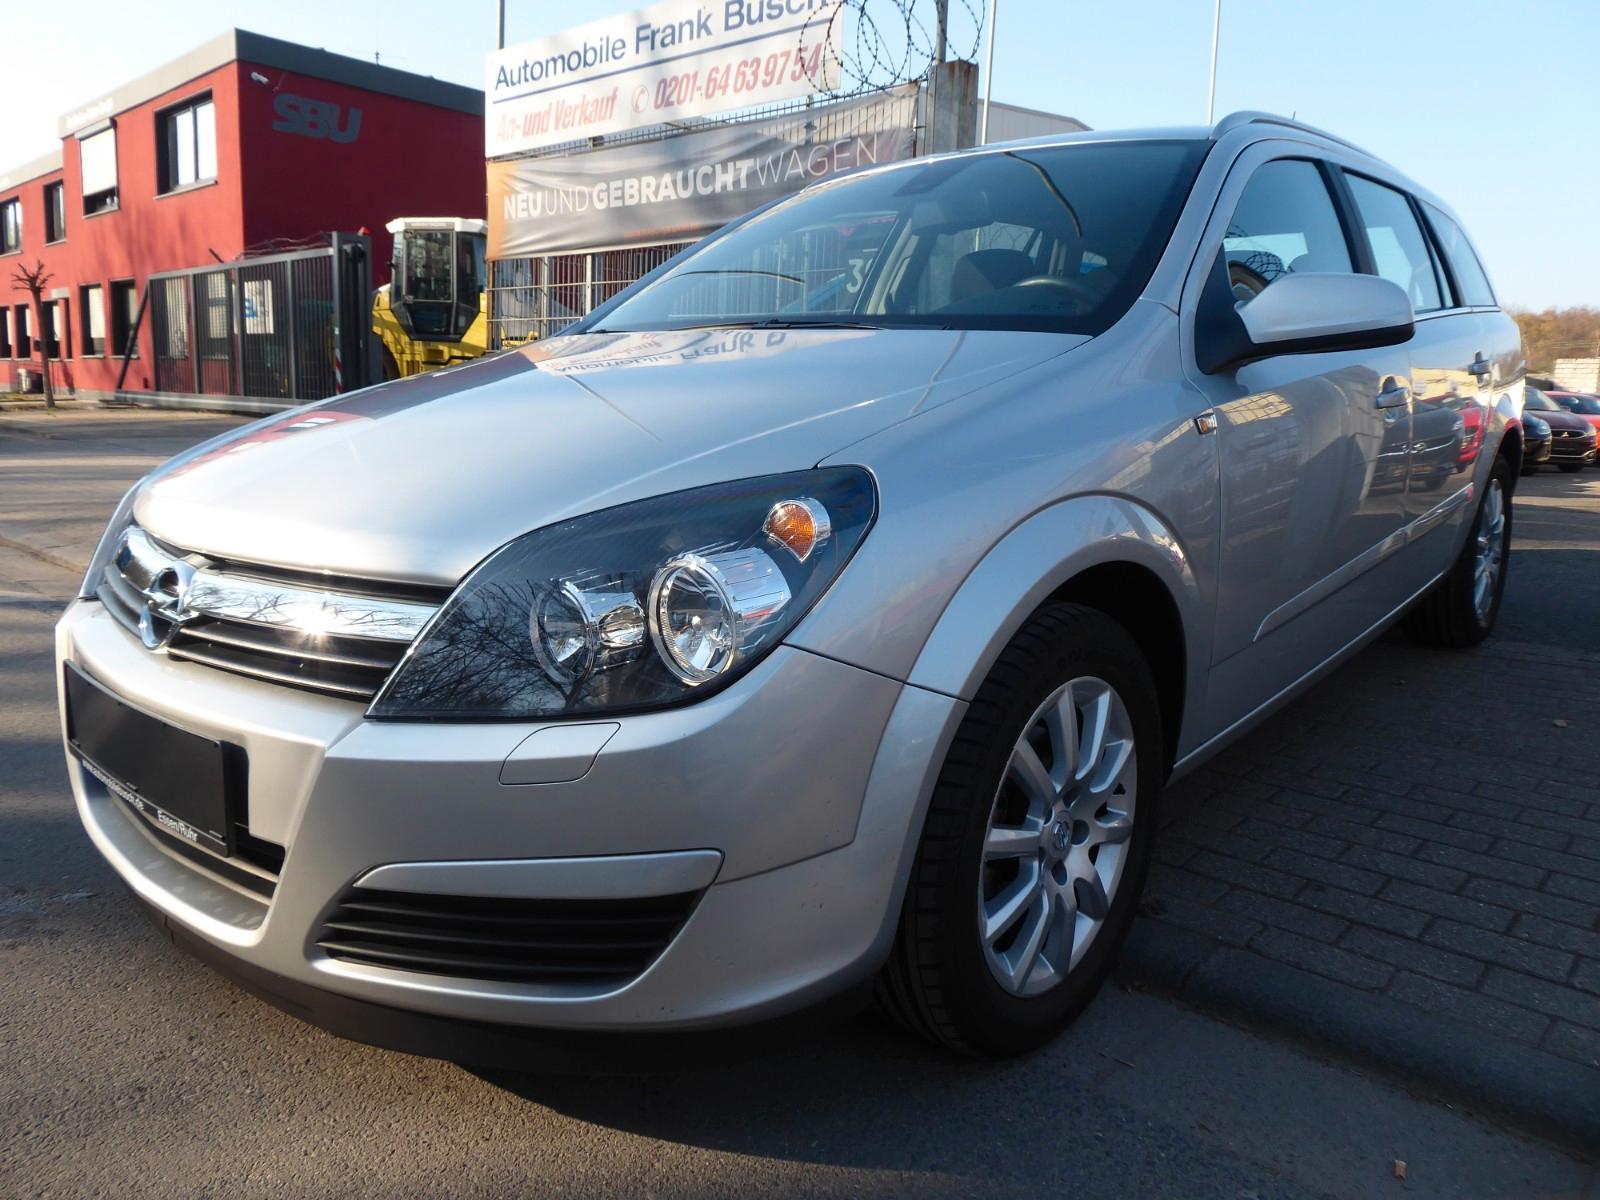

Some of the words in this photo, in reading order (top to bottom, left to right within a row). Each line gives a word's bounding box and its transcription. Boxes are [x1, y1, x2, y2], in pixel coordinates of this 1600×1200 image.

[495, 35, 626, 91] Automobile
[635, 10, 713, 55] Frank
[272, 93, 362, 144] SBU
[522, 102, 553, 137] und
[553, 86, 619, 131] Verkauf
